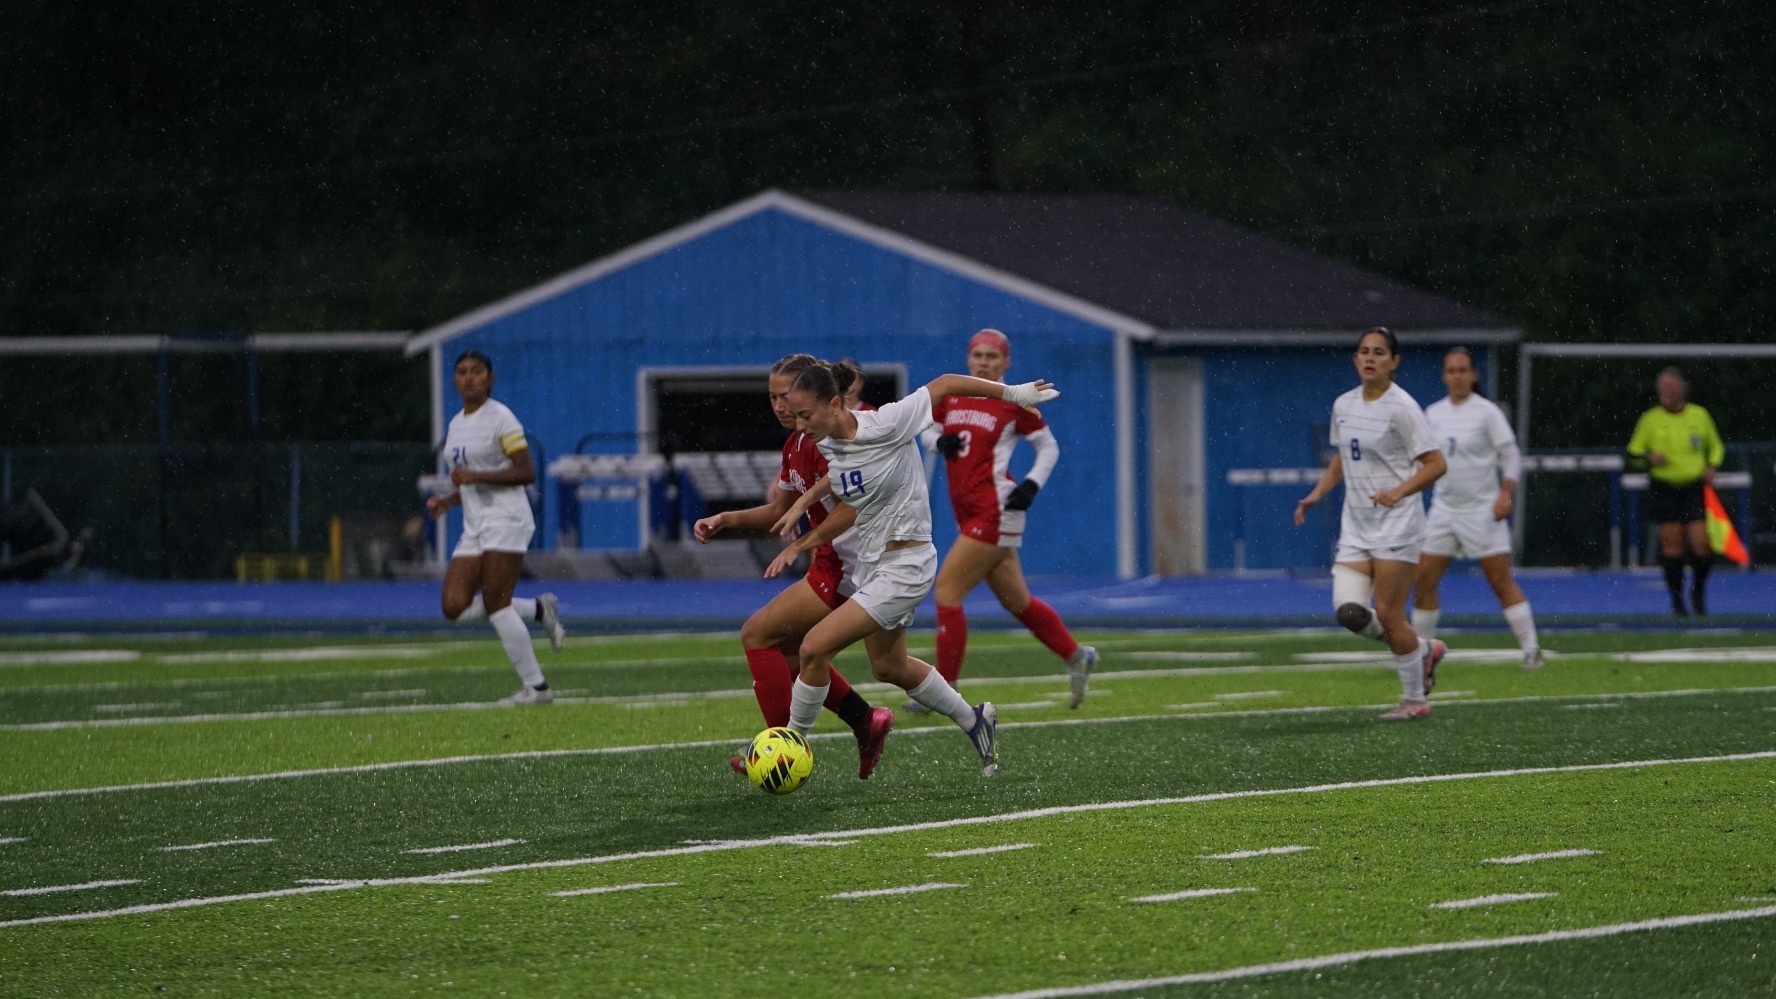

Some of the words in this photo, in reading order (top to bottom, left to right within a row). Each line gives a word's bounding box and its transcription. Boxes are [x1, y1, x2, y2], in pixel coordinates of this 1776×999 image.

[452, 446, 468, 466] 21
[957, 430, 972, 458] 3
[1351, 438, 1361, 461] 8
[839, 470, 865, 497] 19
